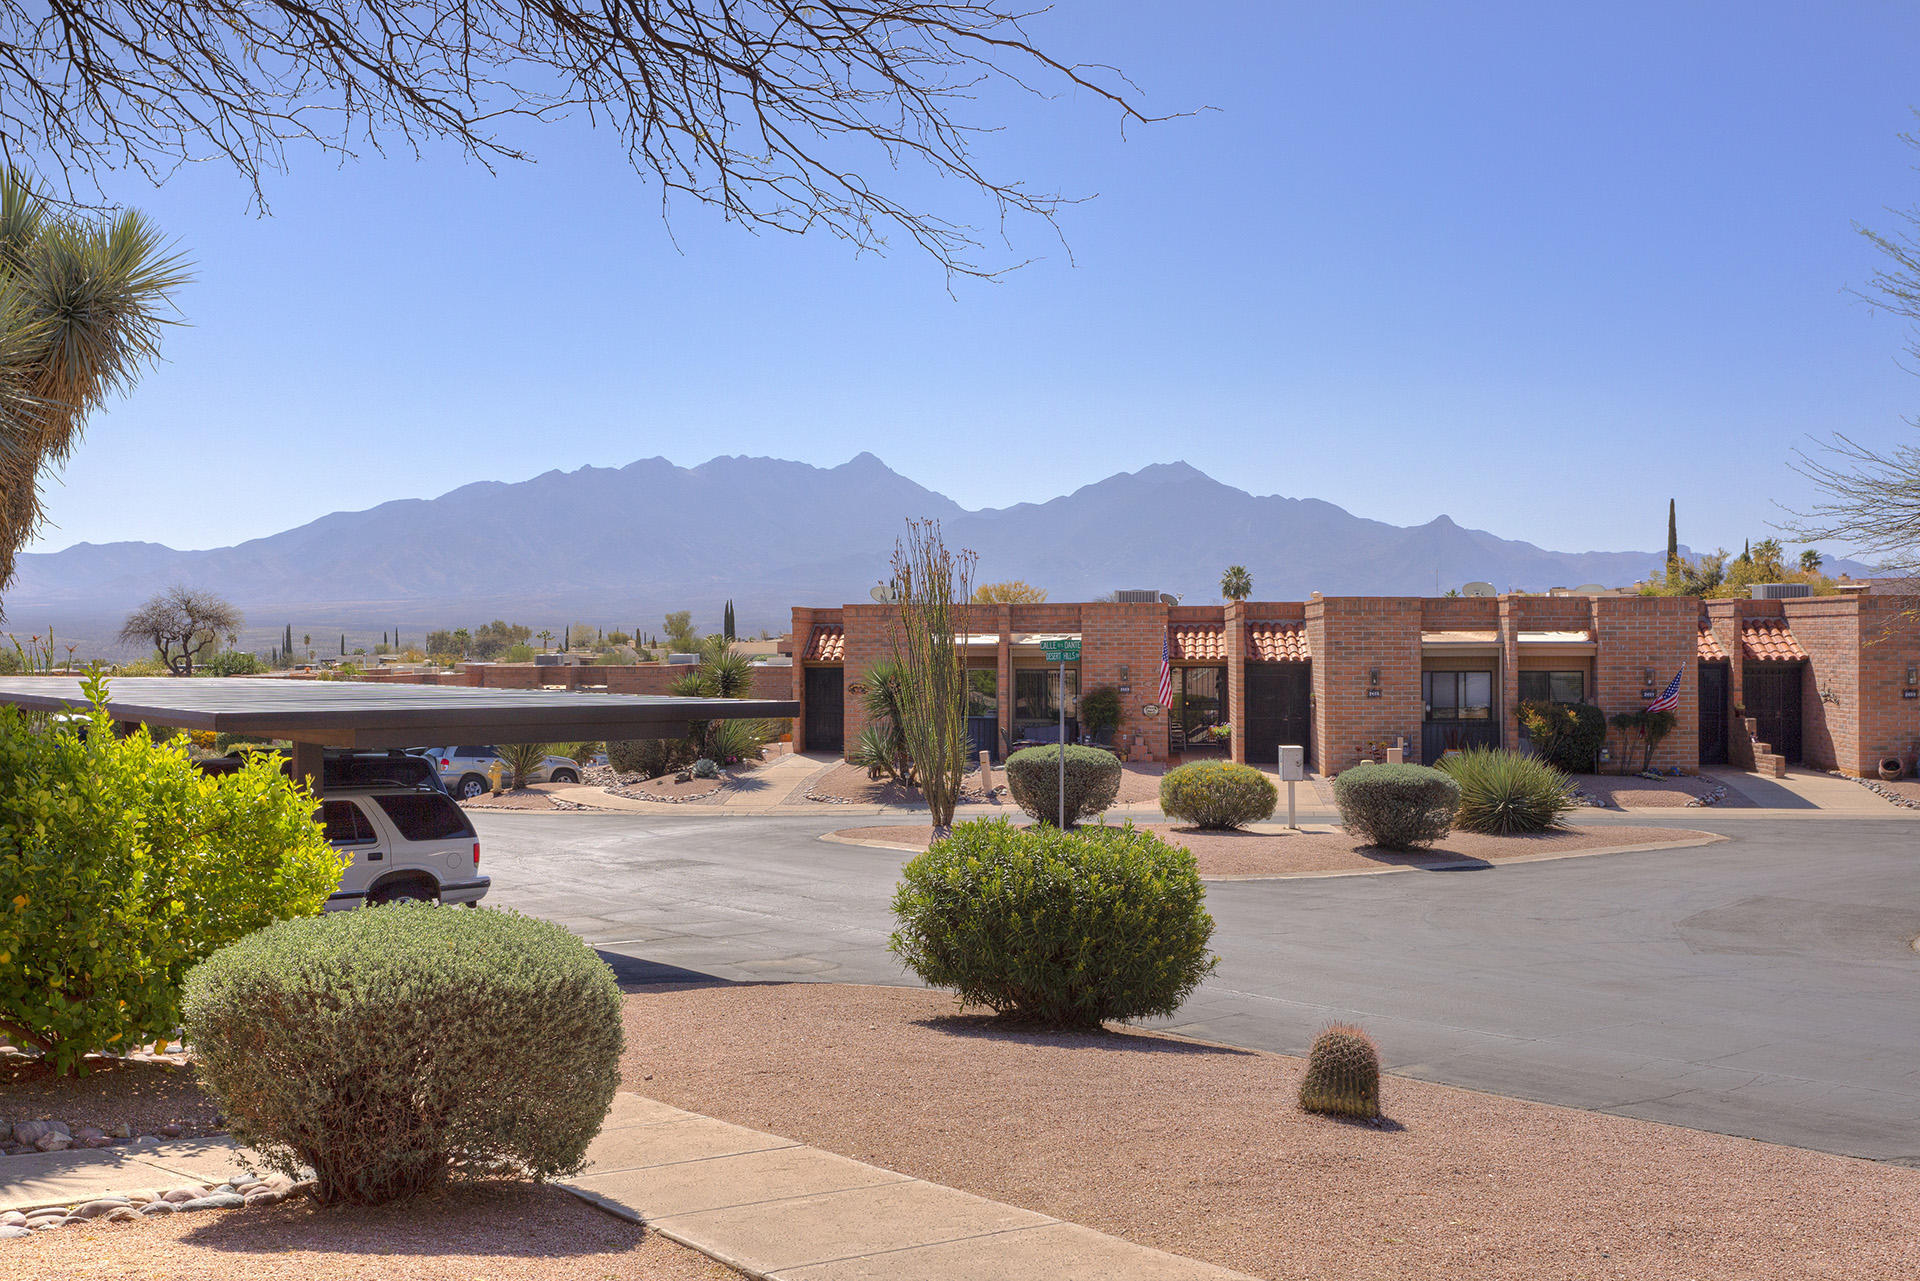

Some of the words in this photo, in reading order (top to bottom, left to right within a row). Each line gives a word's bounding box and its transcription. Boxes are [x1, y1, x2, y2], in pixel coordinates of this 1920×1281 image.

[1040, 641, 1056, 650] CALLE
[1064, 640, 1081, 649] DANTE
[1046, 652, 1061, 660] DESERT
[1063, 652, 1075, 660] HILLS
